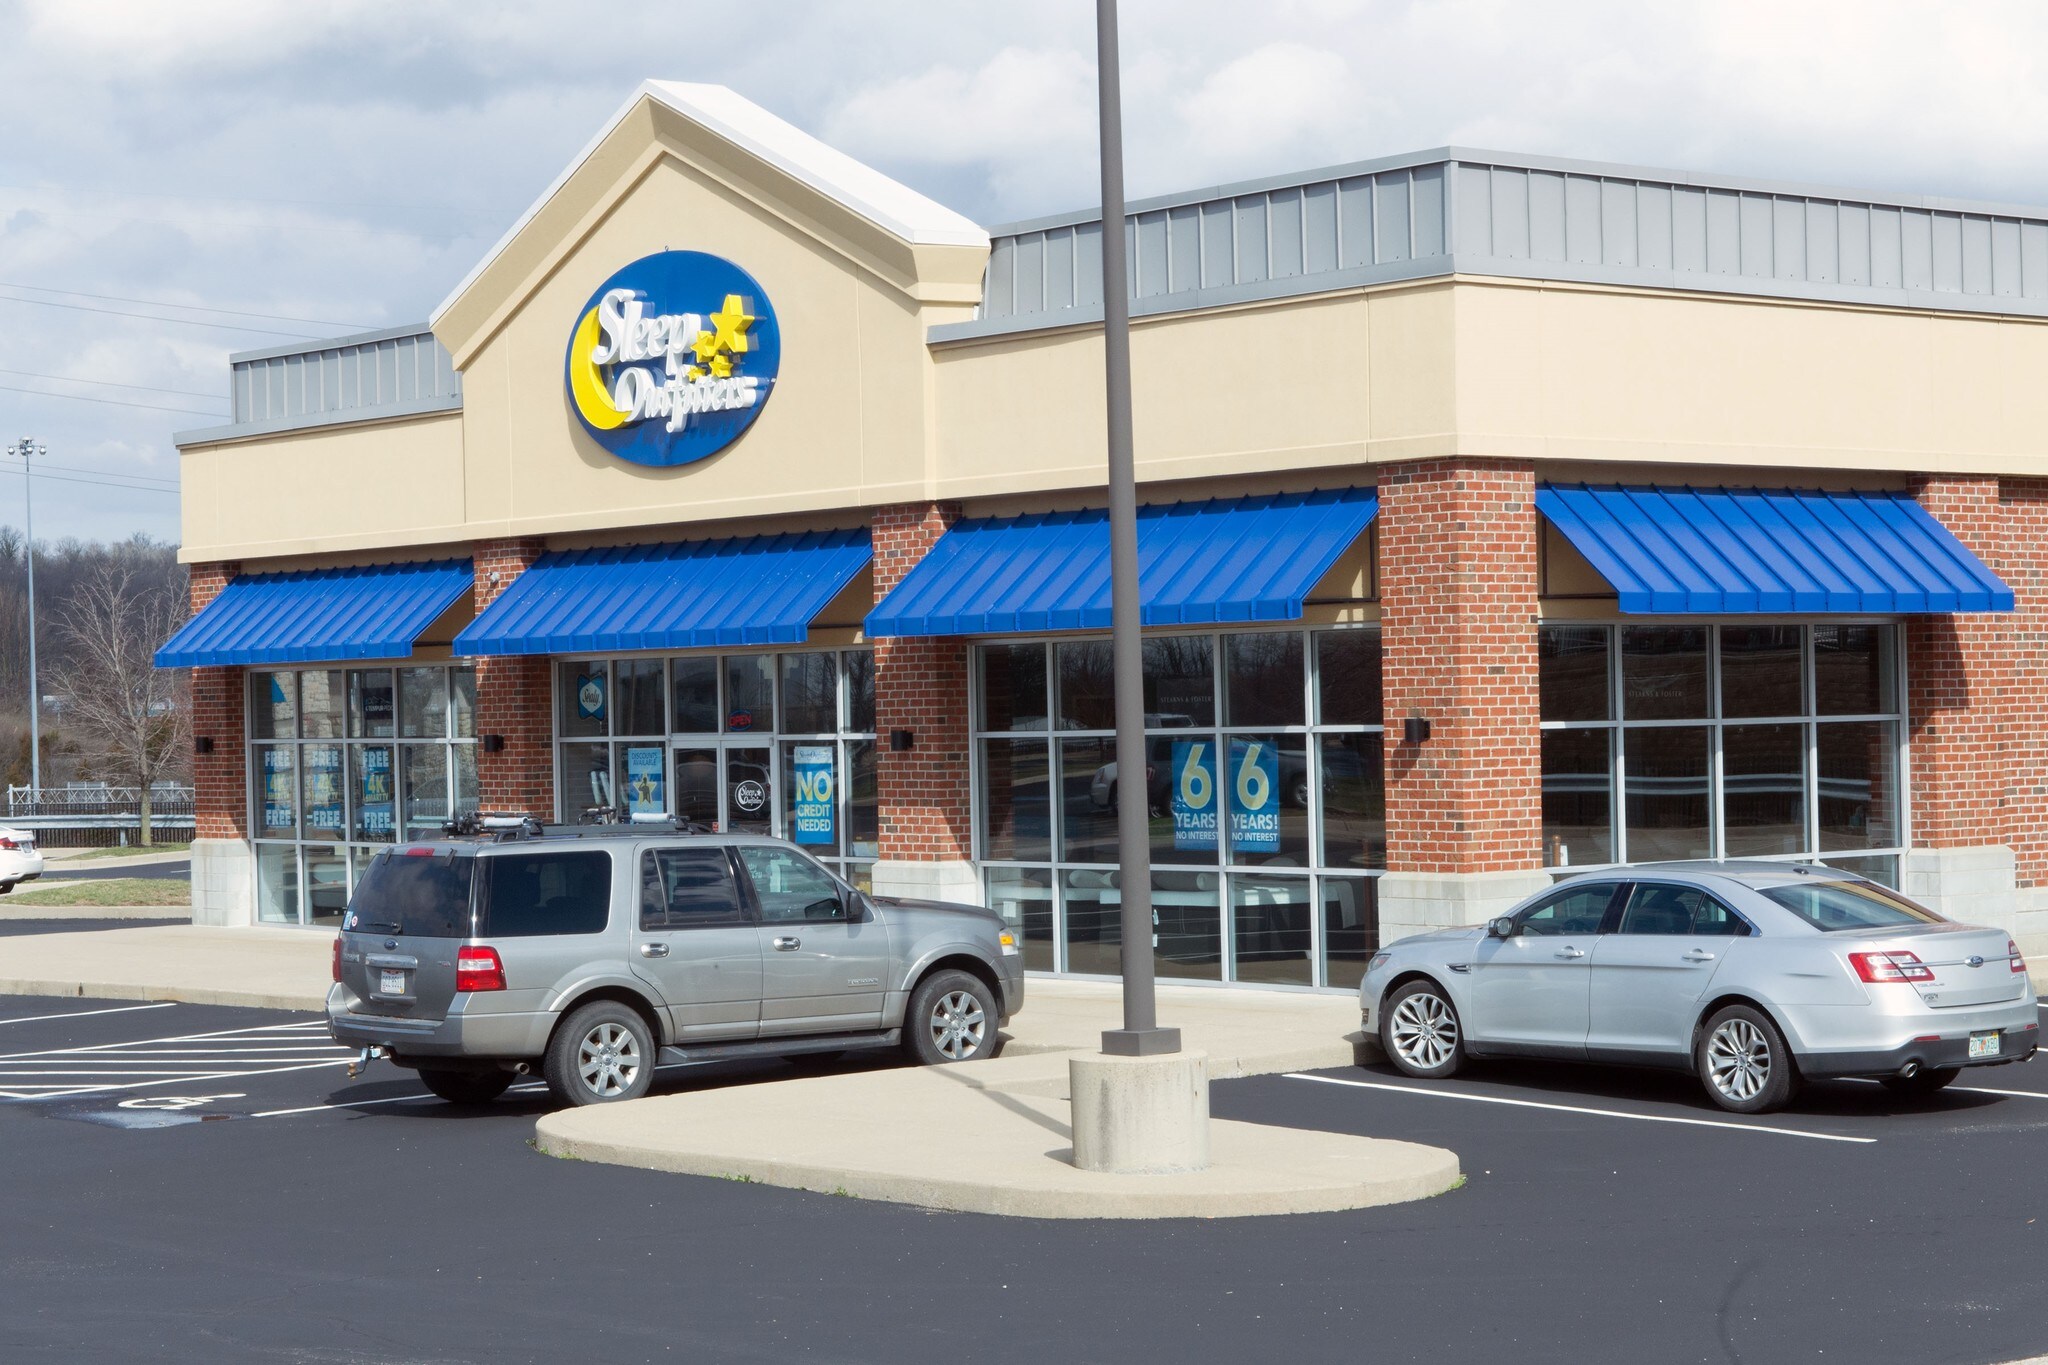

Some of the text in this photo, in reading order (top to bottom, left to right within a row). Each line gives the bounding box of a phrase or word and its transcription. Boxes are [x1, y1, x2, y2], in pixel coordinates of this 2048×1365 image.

[592, 288, 700, 376] Sleep
[615, 365, 757, 432] Outfitters
[729, 714, 752, 727] OPEN
[265, 751, 290, 767] FREE
[312, 750, 338, 767] FREE
[362, 750, 389, 767] FREE
[368, 775, 385, 793] 4K
[1181, 744, 1212, 809] 6
[1237, 744, 1269, 810] 6
[796, 770, 832, 802] NO
[266, 809, 291, 826] FREE
[313, 810, 340, 827] FREE
[797, 804, 831, 817] CREDIT
[364, 812, 390, 829] FREE
[798, 819, 831, 832] NEEDED
[1231, 814, 1278, 830] YEARS!
[1176, 831, 1187, 840] NO
[1231, 832, 1278, 842] NO INTEREST
